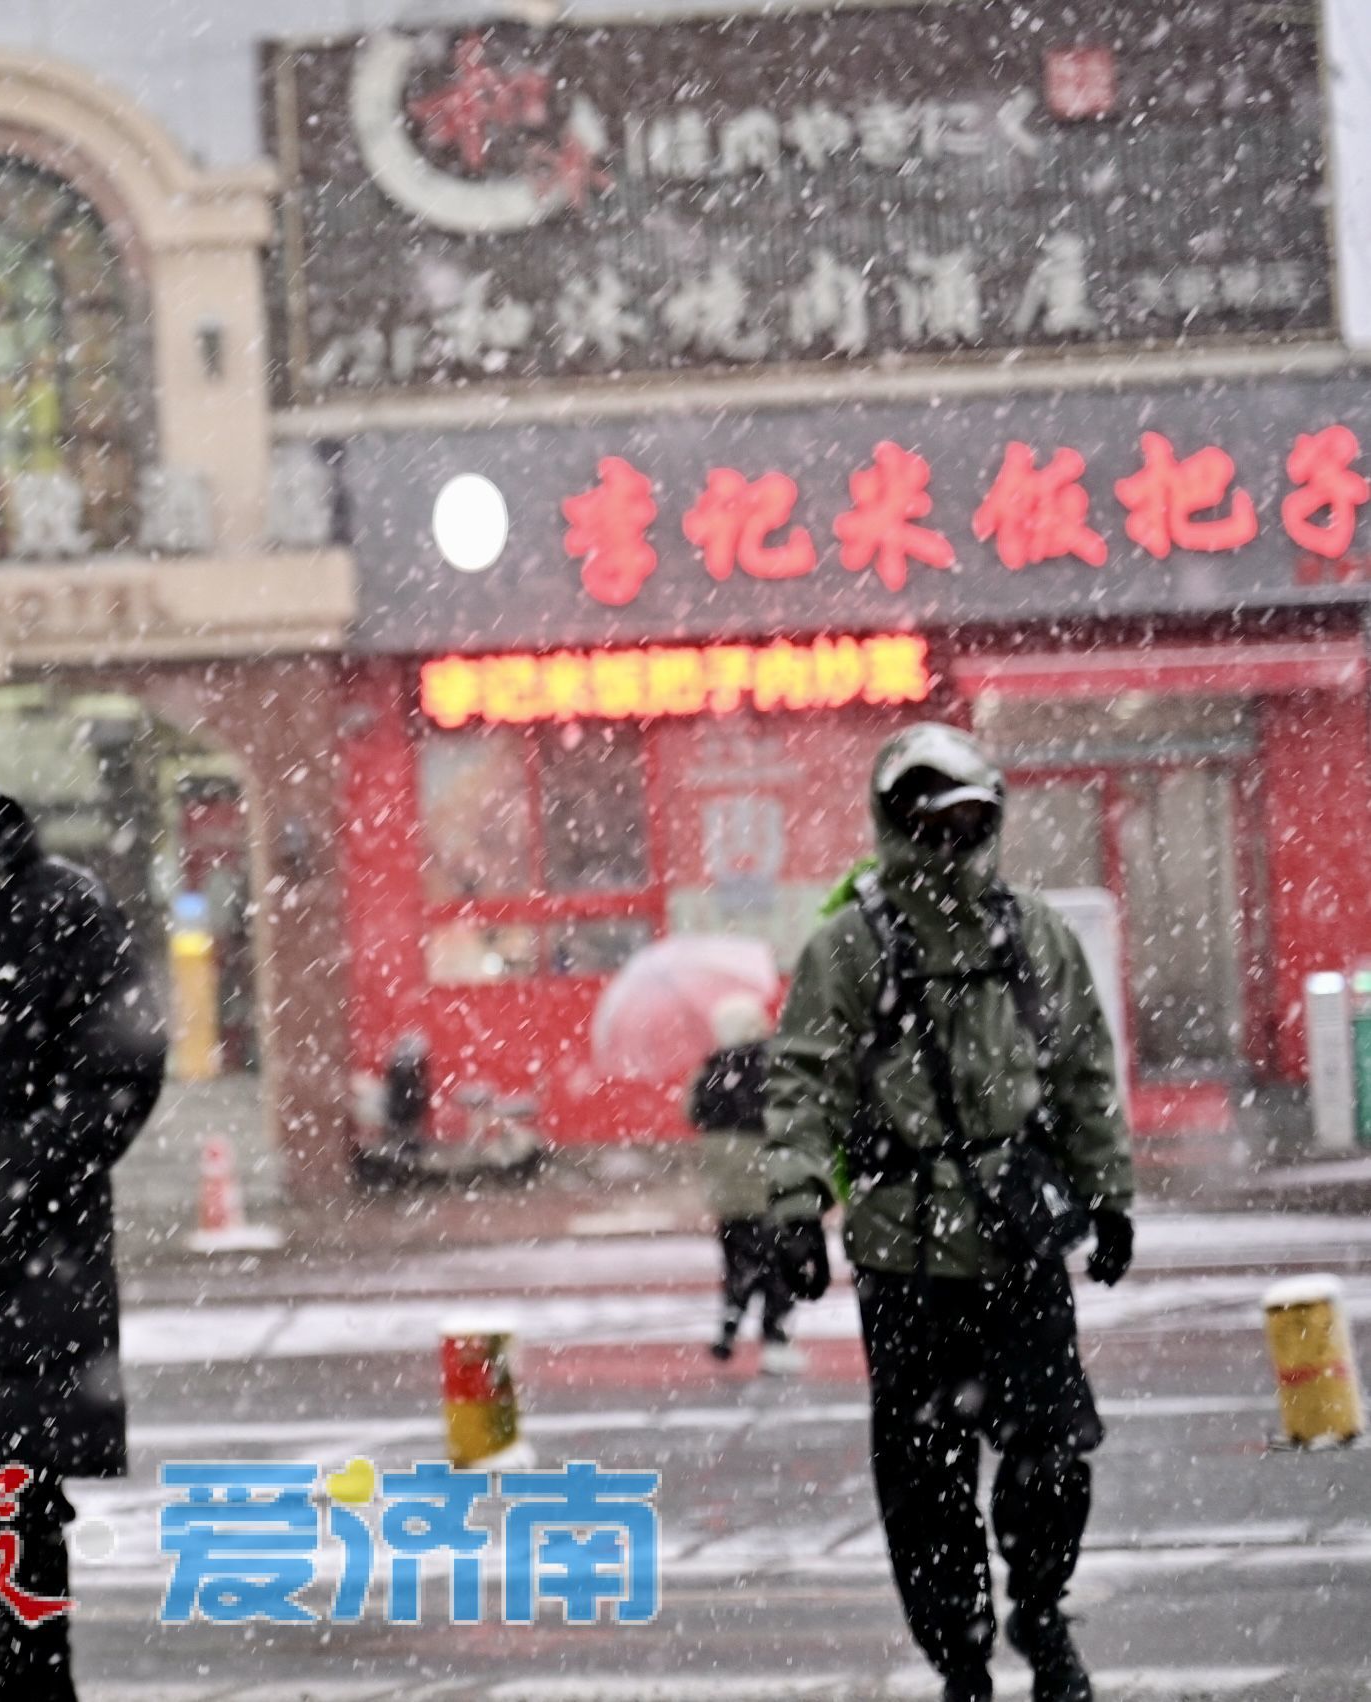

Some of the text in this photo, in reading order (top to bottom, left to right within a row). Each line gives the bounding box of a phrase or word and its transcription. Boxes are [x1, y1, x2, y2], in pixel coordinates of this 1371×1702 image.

[563, 425, 1370, 605] 李记米饭把子
